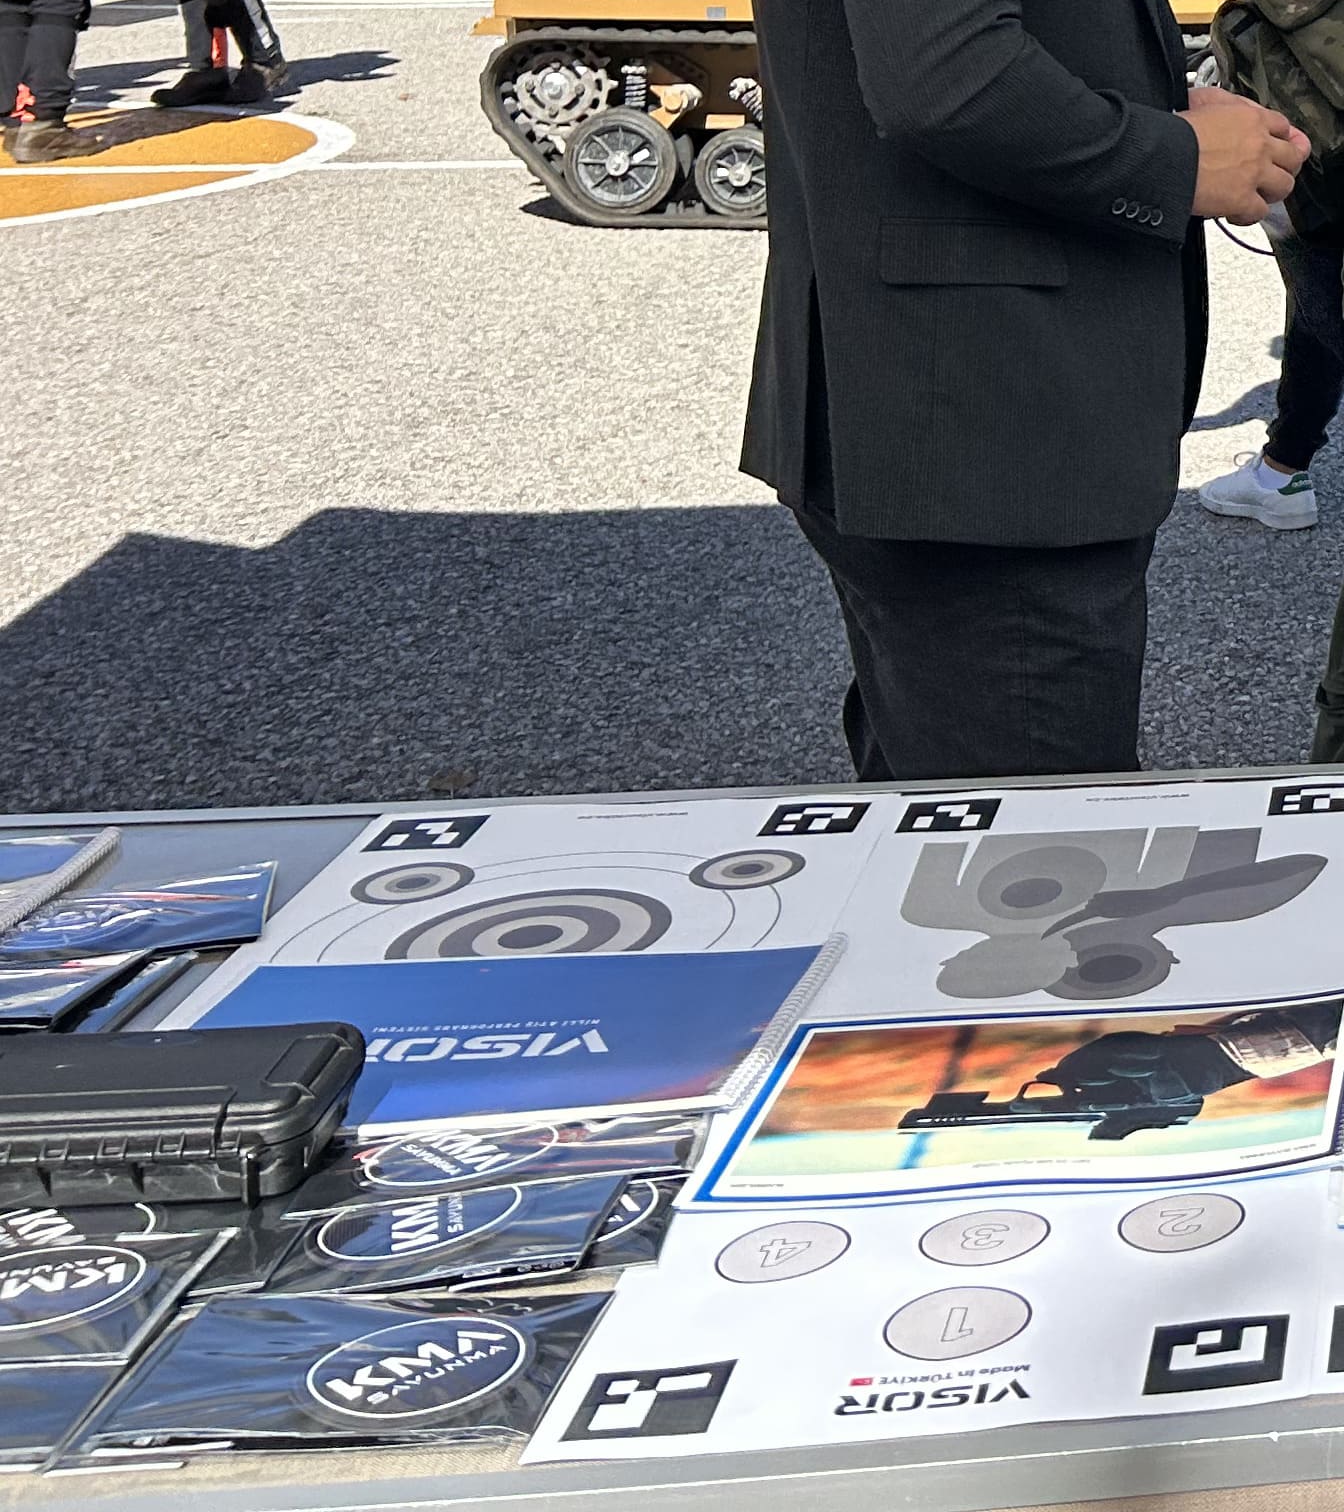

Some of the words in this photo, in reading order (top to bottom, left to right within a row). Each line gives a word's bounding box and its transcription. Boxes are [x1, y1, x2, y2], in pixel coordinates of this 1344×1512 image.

[390, 1196, 440, 1252] KM
[959, 1222, 1011, 1252] 3
[1157, 1206, 1206, 1238] 2
[758, 1237, 812, 1268] 4
[0, 1262, 127, 1299] KM
[938, 1305, 975, 1343] 1
[326, 1329, 510, 1402] KMA
[366, 1345, 510, 1406] SAVUNMA
[879, 1373, 953, 1387] TÜRKİYE
[979, 1364, 1031, 1378] Made
[833, 1378, 1031, 1417] VISOR
